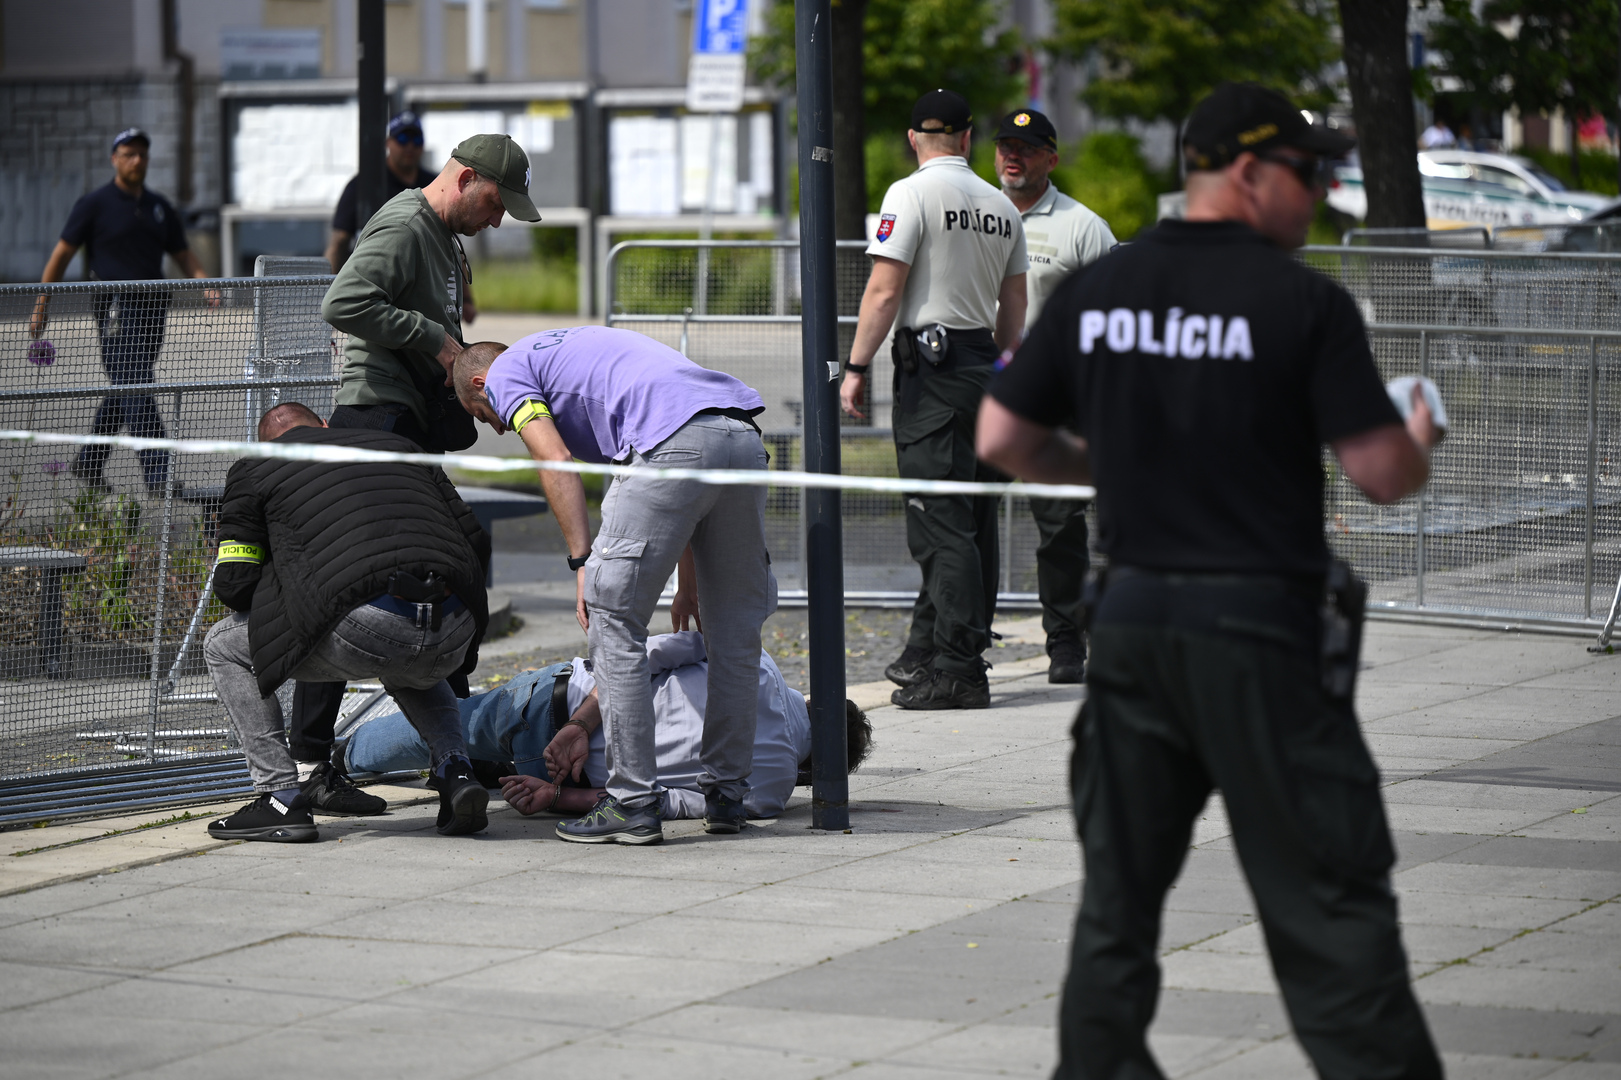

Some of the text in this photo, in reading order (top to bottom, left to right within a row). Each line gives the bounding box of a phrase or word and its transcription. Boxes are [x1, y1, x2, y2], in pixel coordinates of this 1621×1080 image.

[945, 208, 1012, 240] POLÍCIA
[1079, 306, 1254, 362] POLÍCIA
[269, 796, 289, 816] PUMA
